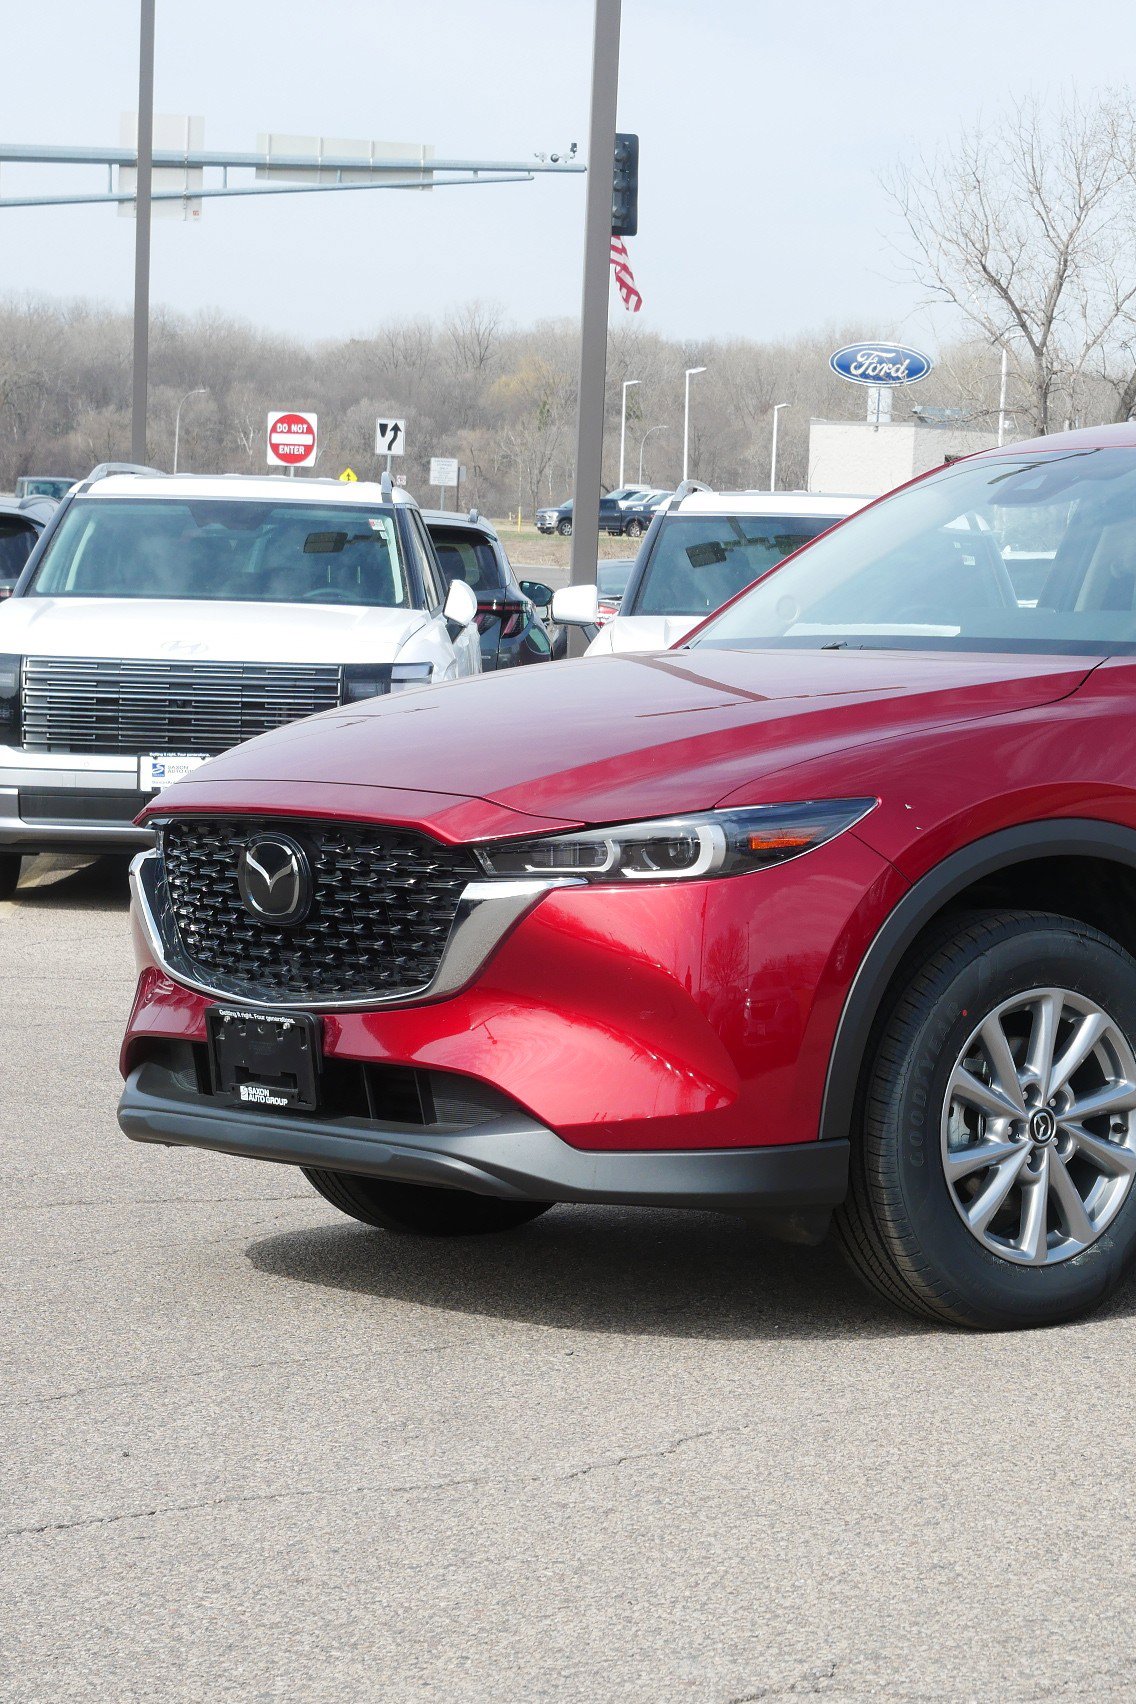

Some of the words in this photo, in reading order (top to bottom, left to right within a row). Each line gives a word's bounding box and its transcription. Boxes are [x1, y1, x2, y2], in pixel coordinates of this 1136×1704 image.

[850, 350, 910, 378] Ford
[277, 423, 288, 433] DO
[291, 424, 308, 433] NOT
[279, 445, 305, 455] ENTER
[248, 1086, 270, 1097] SAXON
[249, 1094, 266, 1103] AUTO
[266, 1096, 288, 1106] GROUP
